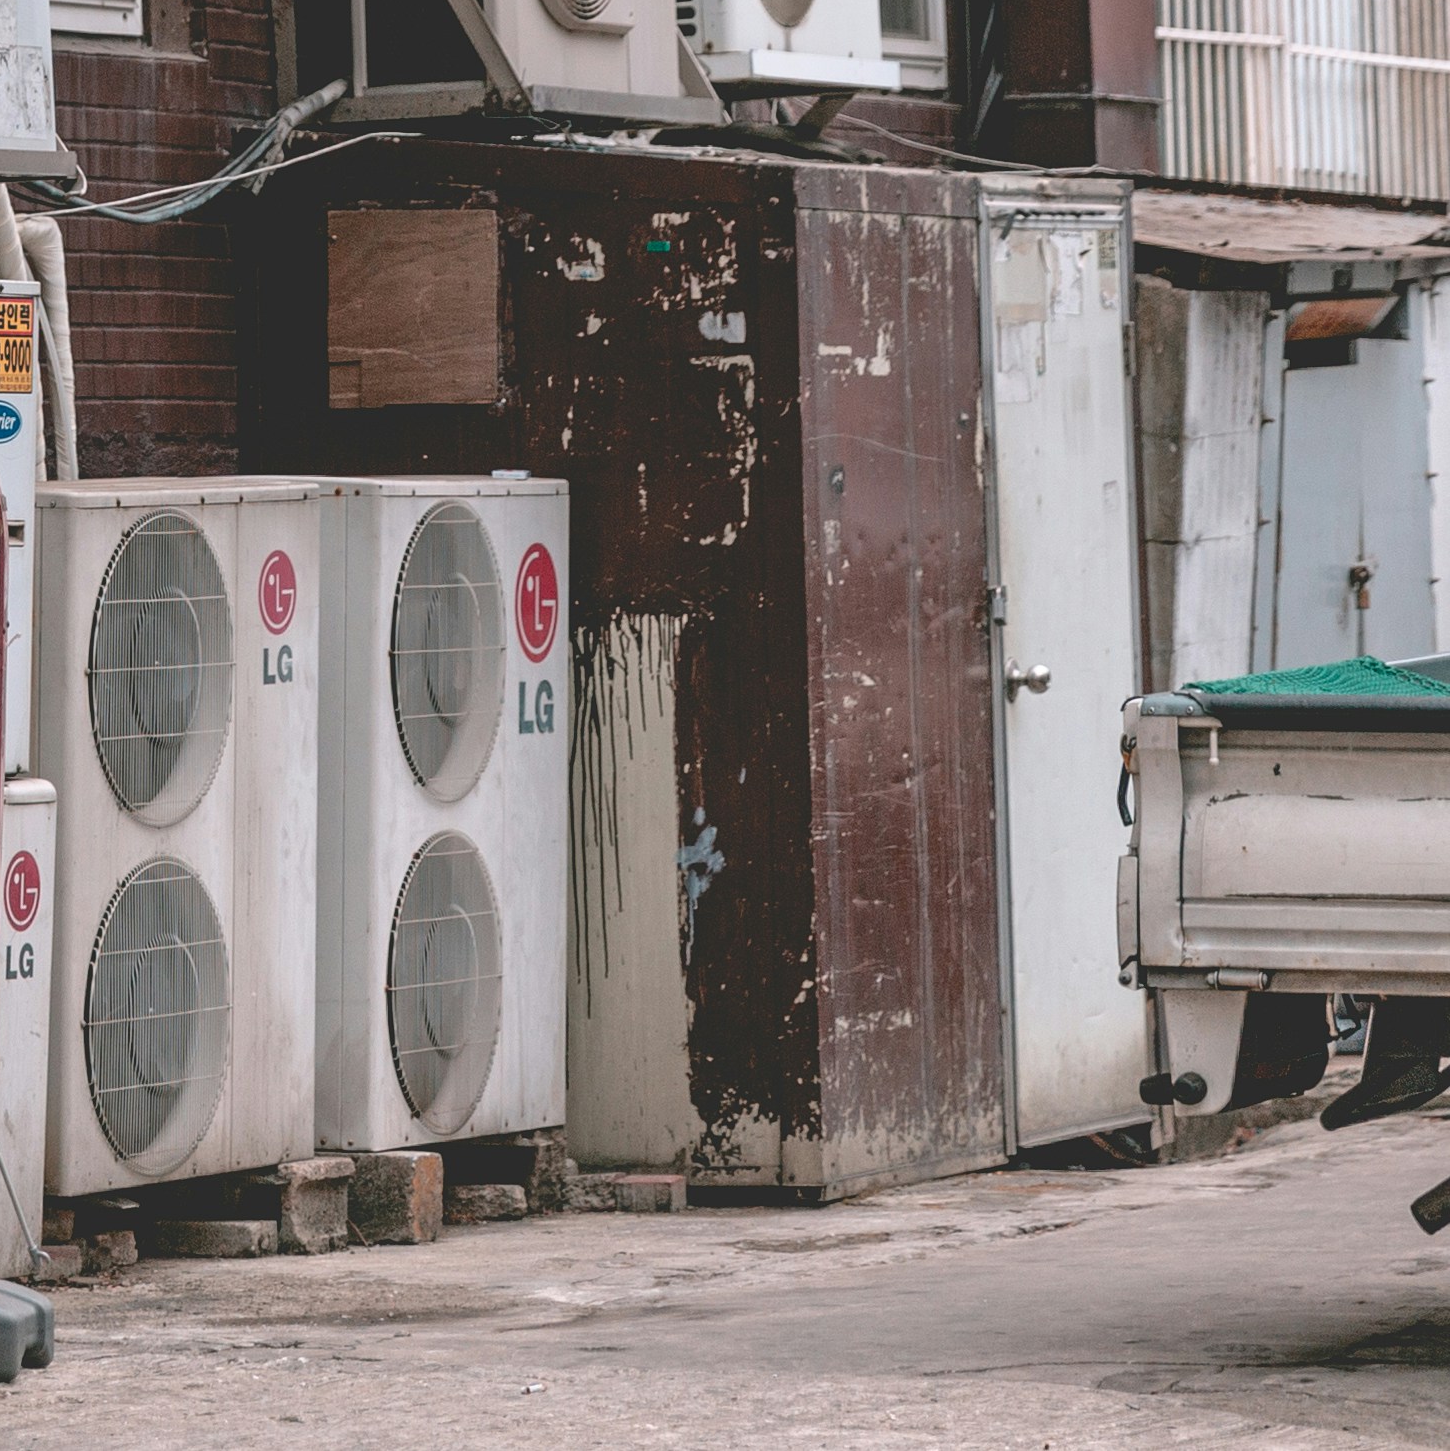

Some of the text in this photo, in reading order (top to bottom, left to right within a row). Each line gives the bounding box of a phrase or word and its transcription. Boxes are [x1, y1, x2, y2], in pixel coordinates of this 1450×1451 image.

[262, 645, 294, 686] LG
[517, 679, 555, 735] LG
[5, 941, 35, 980] LG
